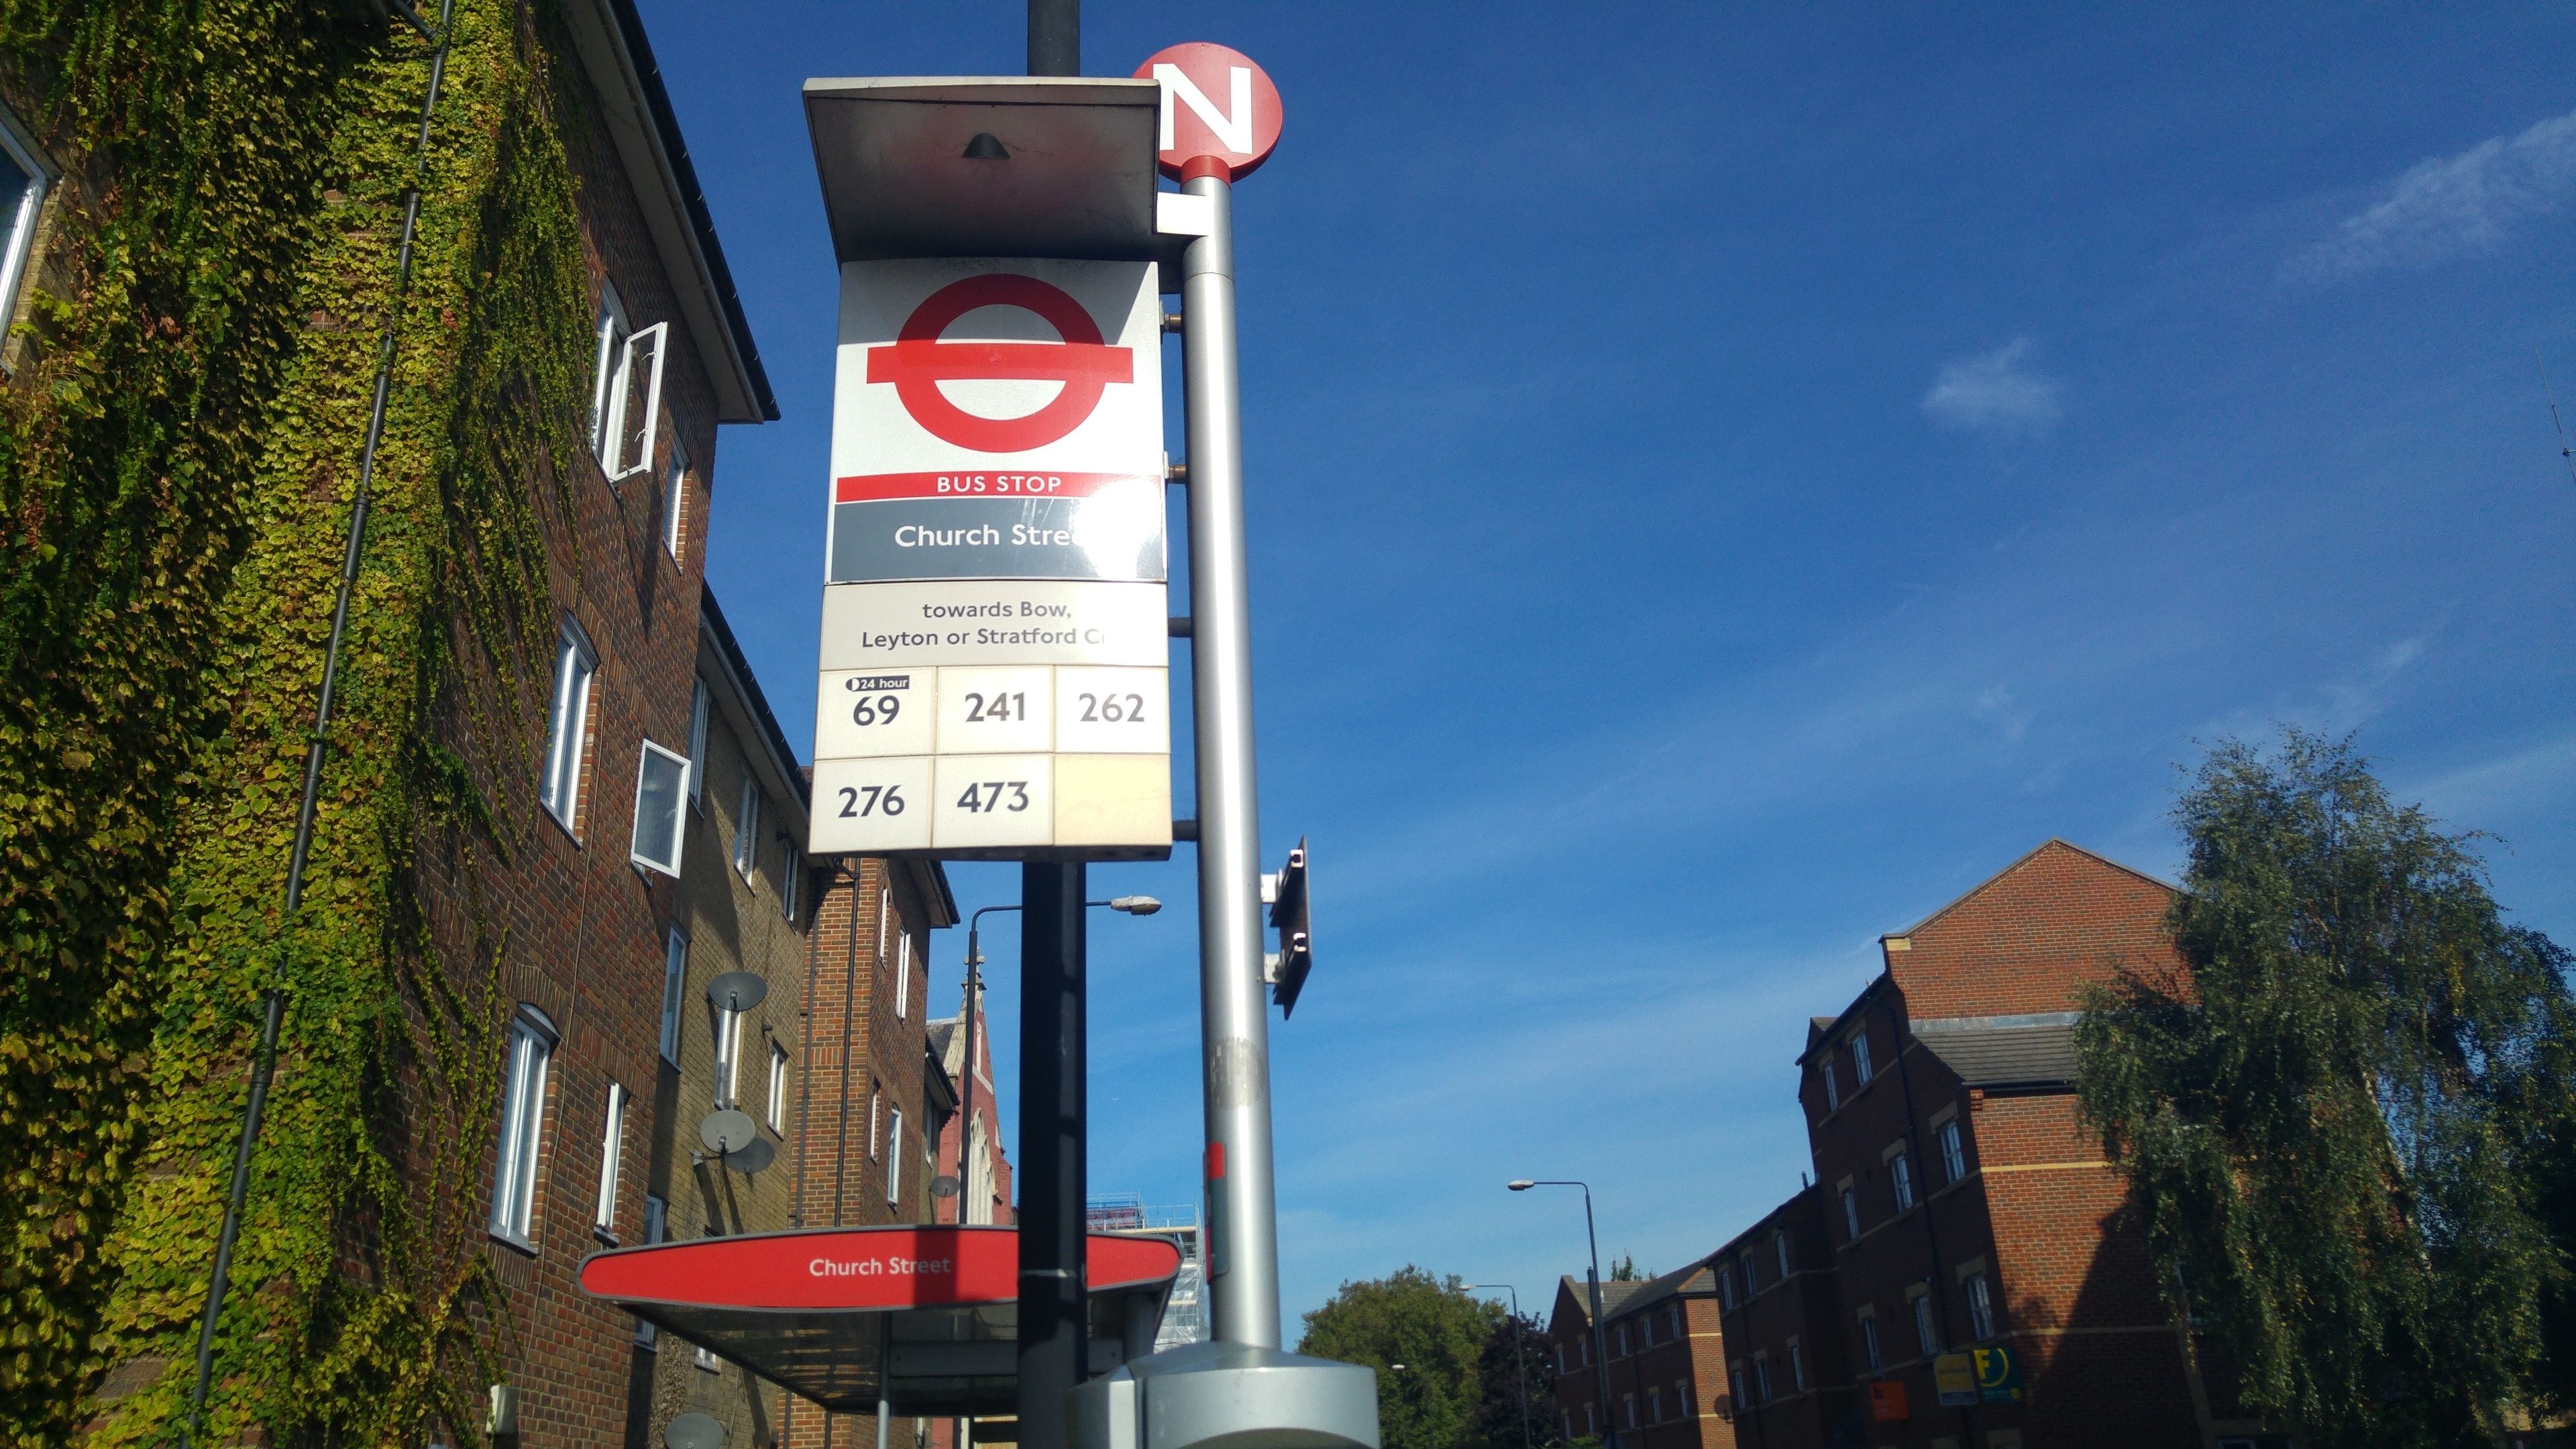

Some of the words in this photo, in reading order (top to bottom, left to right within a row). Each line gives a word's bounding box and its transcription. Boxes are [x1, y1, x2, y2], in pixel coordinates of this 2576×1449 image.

[1152, 63, 1252, 154] N
[937, 475, 985, 493] BUS
[996, 475, 1061, 493] STOP
[894, 524, 1000, 547] Church
[1011, 523, 1081, 546] Stre
[922, 601, 1013, 619] towards
[1020, 601, 1072, 619] Bow,
[862, 631, 938, 651] Leyton
[947, 630, 970, 645] or
[977, 627, 1077, 645] Stratford
[860, 679, 875, 690] 24
[879, 678, 908, 689] hour
[853, 695, 900, 726] 69
[965, 692, 1025, 722] 241
[1079, 694, 1145, 722] 262
[838, 785, 905, 818] 276
[957, 781, 1028, 812] 473
[809, 1258, 882, 1277] Church
[889, 1256, 951, 1275] Street
